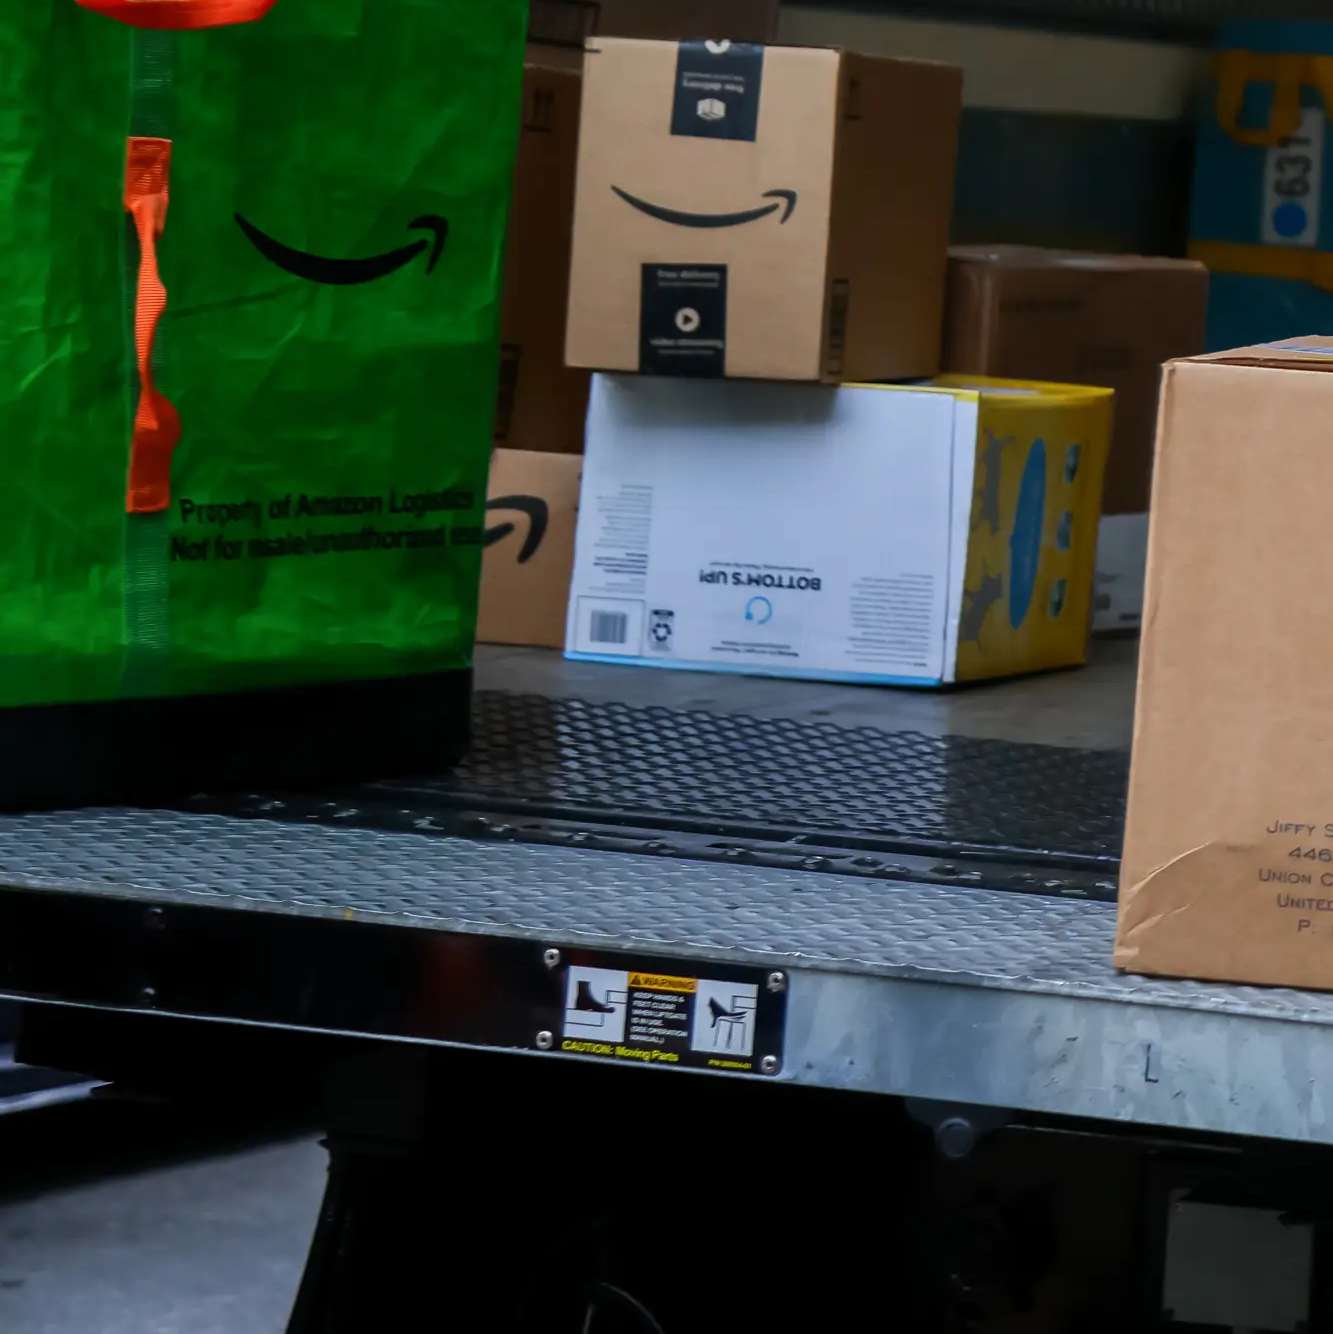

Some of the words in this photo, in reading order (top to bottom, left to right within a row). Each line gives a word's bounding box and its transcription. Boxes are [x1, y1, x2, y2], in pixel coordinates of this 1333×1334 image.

[178, 497, 263, 528] Property
[268, 493, 292, 519] of
[297, 492, 384, 516] Amazon
[389, 487, 475, 518] Logistics
[170, 535, 208, 563] Not
[213, 533, 243, 561] for
[697, 567, 728, 583] UP!
[731, 569, 821, 592] BOTTOM'S
[1266, 820, 1316, 837] JIFFY
[1258, 868, 1312, 886] UNION
[642, 976, 696, 991] WARNING
[561, 1039, 614, 1056] CAUTION:
[615, 1043, 651, 1061] Moving
[651, 1049, 680, 1063] Parts
